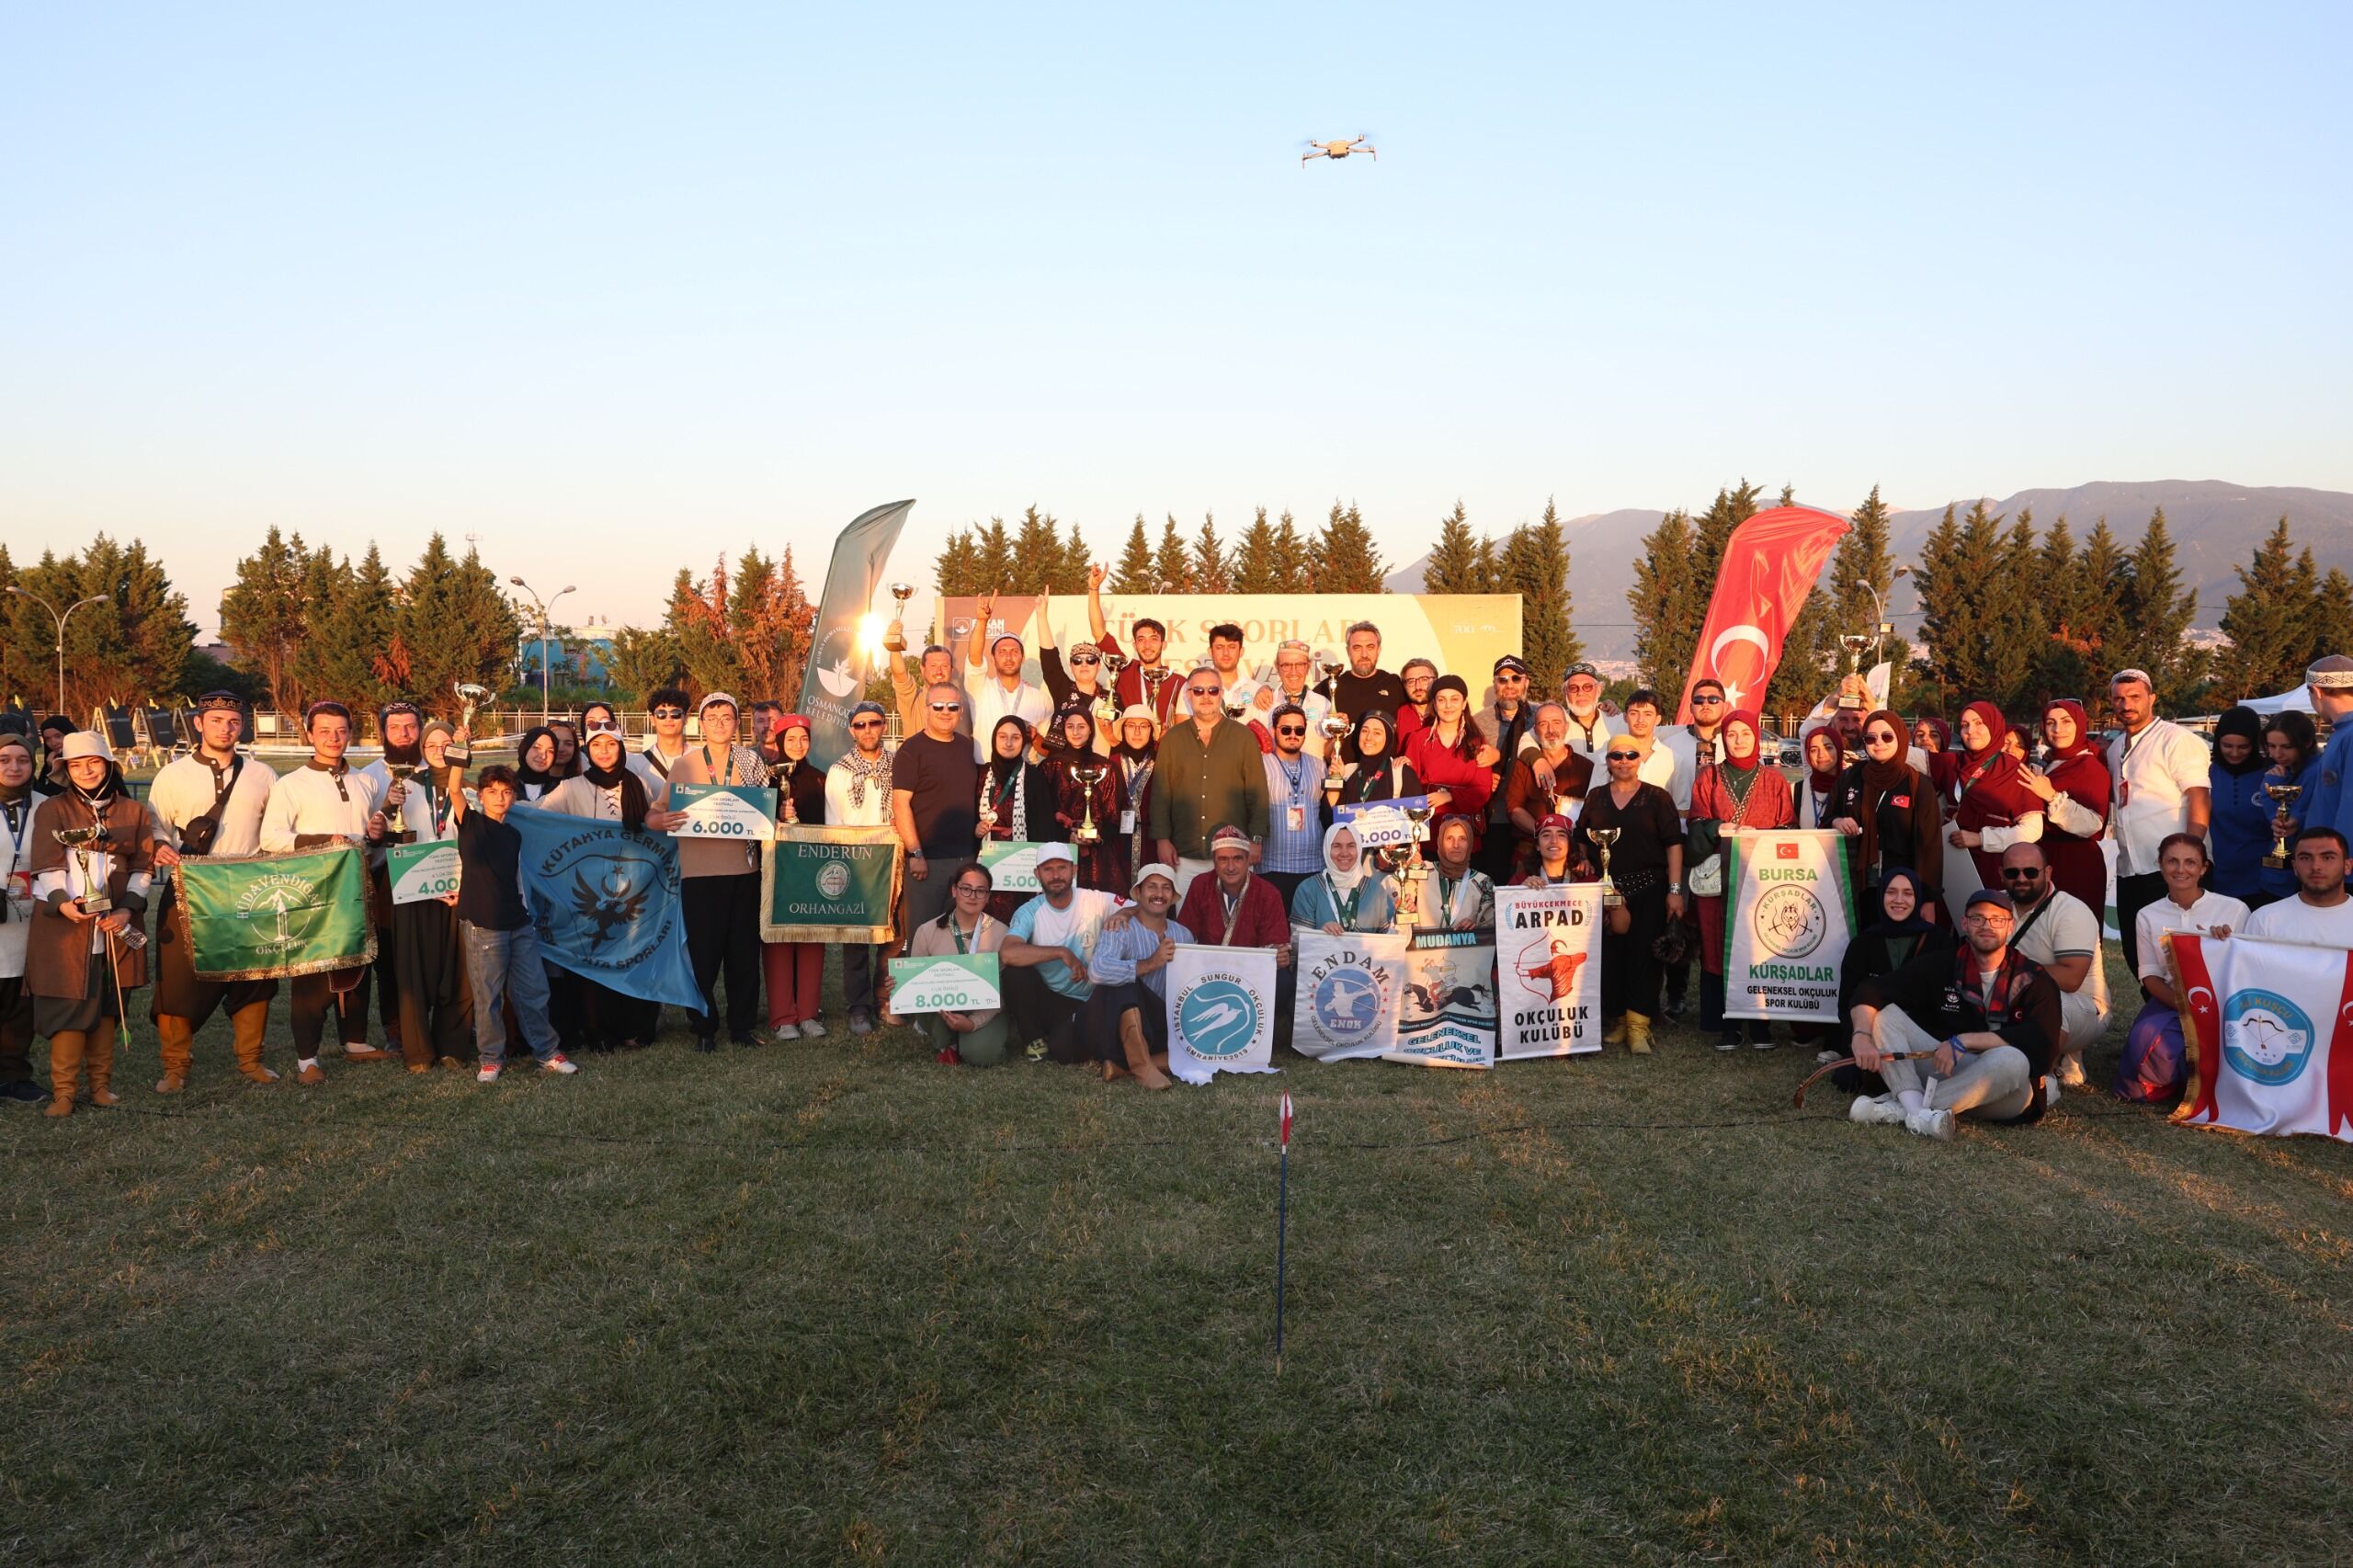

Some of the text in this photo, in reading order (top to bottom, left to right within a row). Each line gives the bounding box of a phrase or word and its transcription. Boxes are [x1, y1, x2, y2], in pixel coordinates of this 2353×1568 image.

[692, 821, 744, 835] 6.000
[542, 830, 614, 872] KÜTAHYA
[798, 845, 872, 859] ENDERUN
[1003, 875, 1039, 887] 5.00
[1758, 869, 1818, 881] BURSA
[418, 877, 460, 894] 4.00
[790, 902, 865, 915] ORHANGAZİ
[1515, 900, 1582, 909] BÜYÜKÇEKMECE
[1515, 910, 1584, 928] ARPAD
[1415, 932, 1477, 948] MUDANYA
[1311, 951, 1390, 984] ENDAM
[1749, 961, 1834, 983] KÜRŞADLAR
[1200, 973, 1242, 984] SUNGUR
[1747, 985, 1837, 999] GELENEKSEL OKÇULUK
[915, 993, 968, 1007] 8.000
[1765, 998, 1820, 1009] SPOR KULÜBÜ
[1329, 1018, 1362, 1028] ENOK
[1515, 1006, 1588, 1026] OKÇULUK
[1407, 1026, 1482, 1045] GELENEKSEL
[1519, 1021, 1583, 1044] KULÜBÜ
[1464, 1045, 1482, 1055] VE
